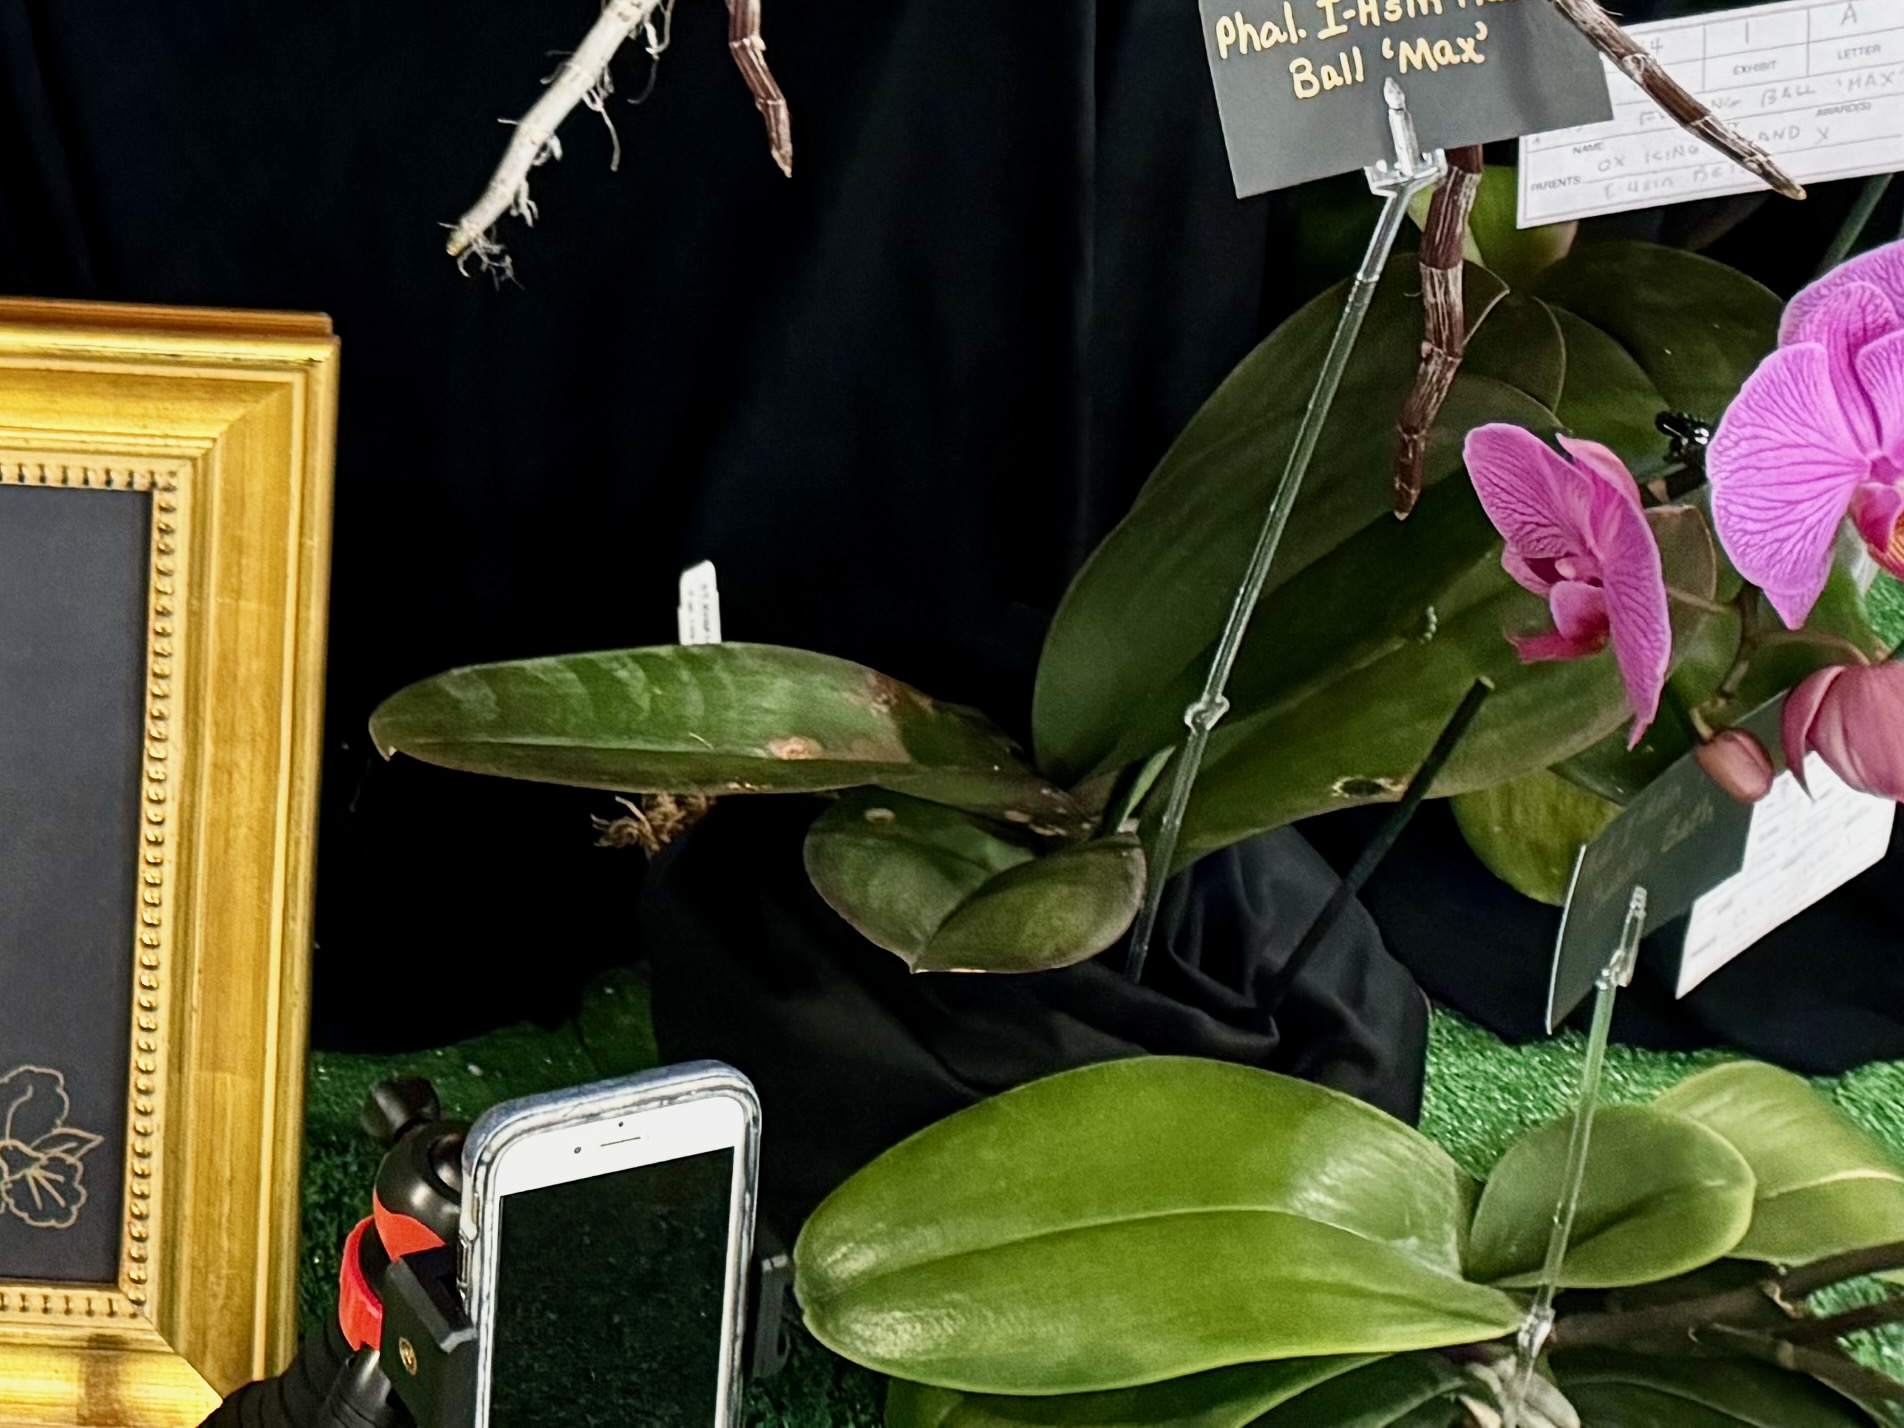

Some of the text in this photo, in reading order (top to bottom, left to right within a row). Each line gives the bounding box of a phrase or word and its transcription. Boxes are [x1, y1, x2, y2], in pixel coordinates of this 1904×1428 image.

[1215, 1, 1307, 60] Phal.
[1289, 20, 1488, 99] Ball 'Max'
[1838, 44, 1882, 61] LETTER
[1733, 60, 1777, 76] EXHIBIT
[1531, 175, 1581, 192] PARENTS
